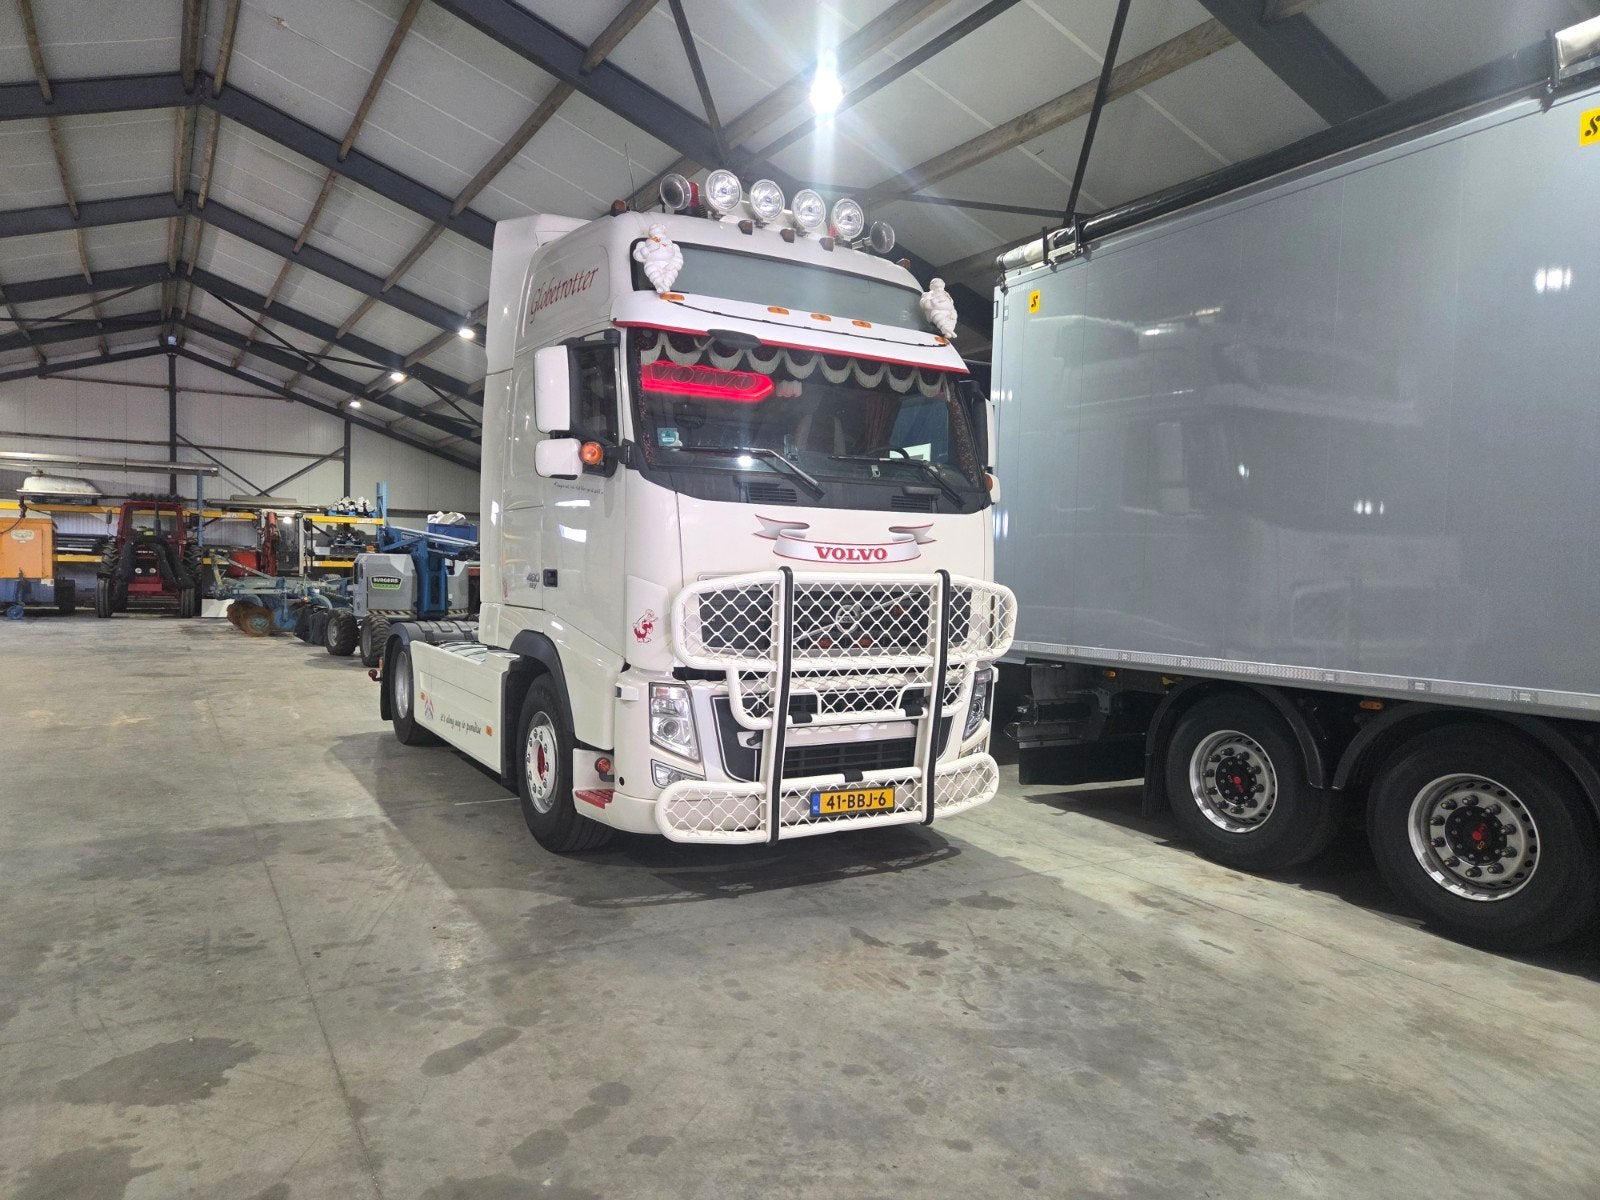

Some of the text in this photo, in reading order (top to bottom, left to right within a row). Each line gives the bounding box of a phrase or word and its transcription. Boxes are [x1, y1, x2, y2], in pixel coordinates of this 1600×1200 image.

[530, 268, 599, 324] Globetrotter
[814, 545, 888, 560] VOLVO
[827, 792, 886, 810] 41-BBJ-6
